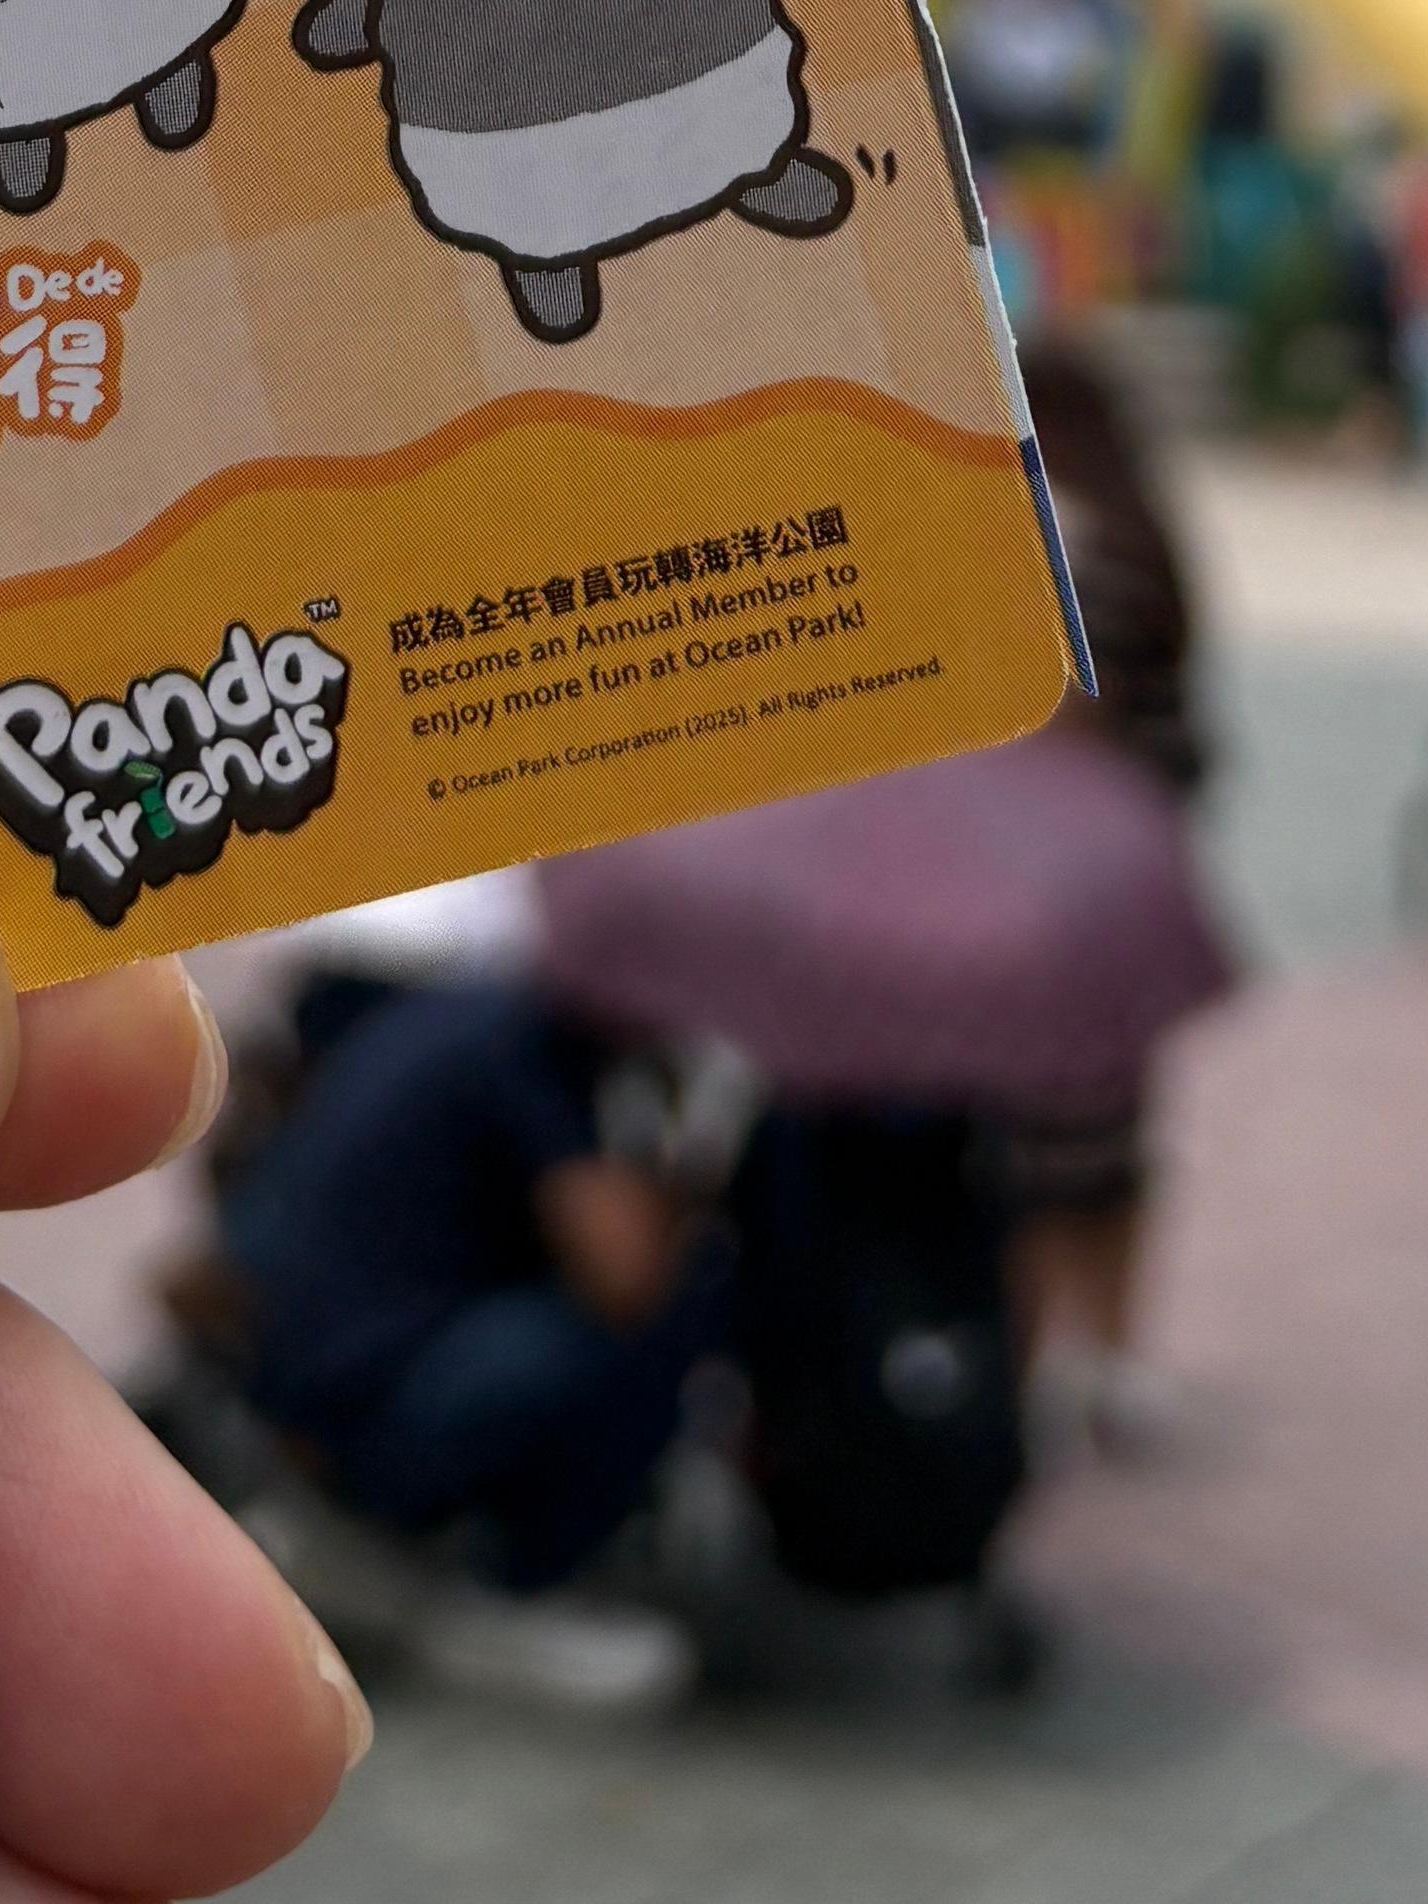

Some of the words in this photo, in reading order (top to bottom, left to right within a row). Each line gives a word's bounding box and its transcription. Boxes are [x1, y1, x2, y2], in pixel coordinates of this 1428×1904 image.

[388, 504, 849, 655] 成為全年會員玩轉海洋公園
[398, 647, 522, 697] Become
[530, 634, 568, 664] an
[575, 599, 683, 652] Annual
[690, 570, 819, 622] Member
[824, 561, 859, 590] to
[410, 698, 496, 738] enjoy
[503, 676, 583, 715] more
[589, 661, 641, 693] fun
[648, 652, 679, 680] at
[684, 625, 782, 669] Ocean
[786, 599, 867, 642] Park!
[451, 762, 513, 793] Ocean
[516, 752, 562, 783] Park
[564, 722, 681, 766] Corporation
[758, 695, 783, 719] All
[787, 679, 848, 713] Rights
[63, 703, 334, 879] friends
